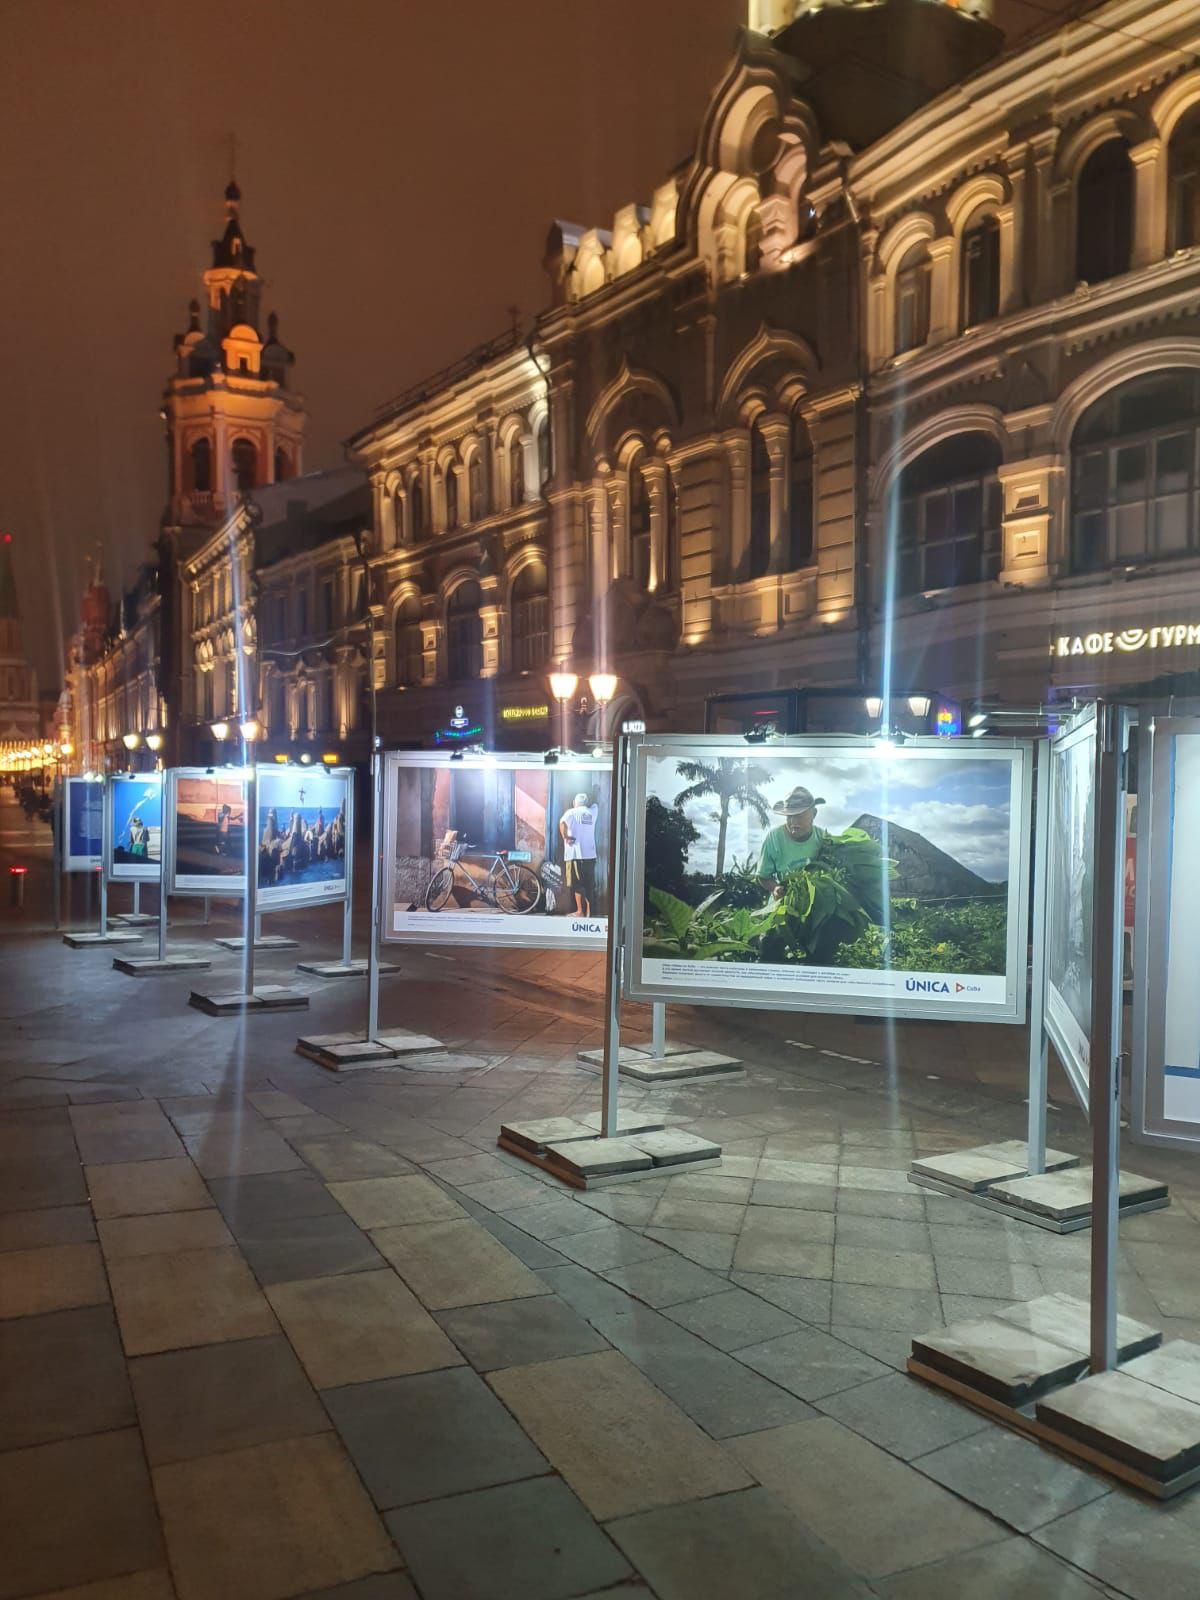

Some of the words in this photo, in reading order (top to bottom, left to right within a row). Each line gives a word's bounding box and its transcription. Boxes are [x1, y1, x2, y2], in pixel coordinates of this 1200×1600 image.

[1057, 632, 1114, 657] КАФЕ
[571, 921, 601, 933] ÚNICA
[905, 977, 950, 993] ÚNICA
